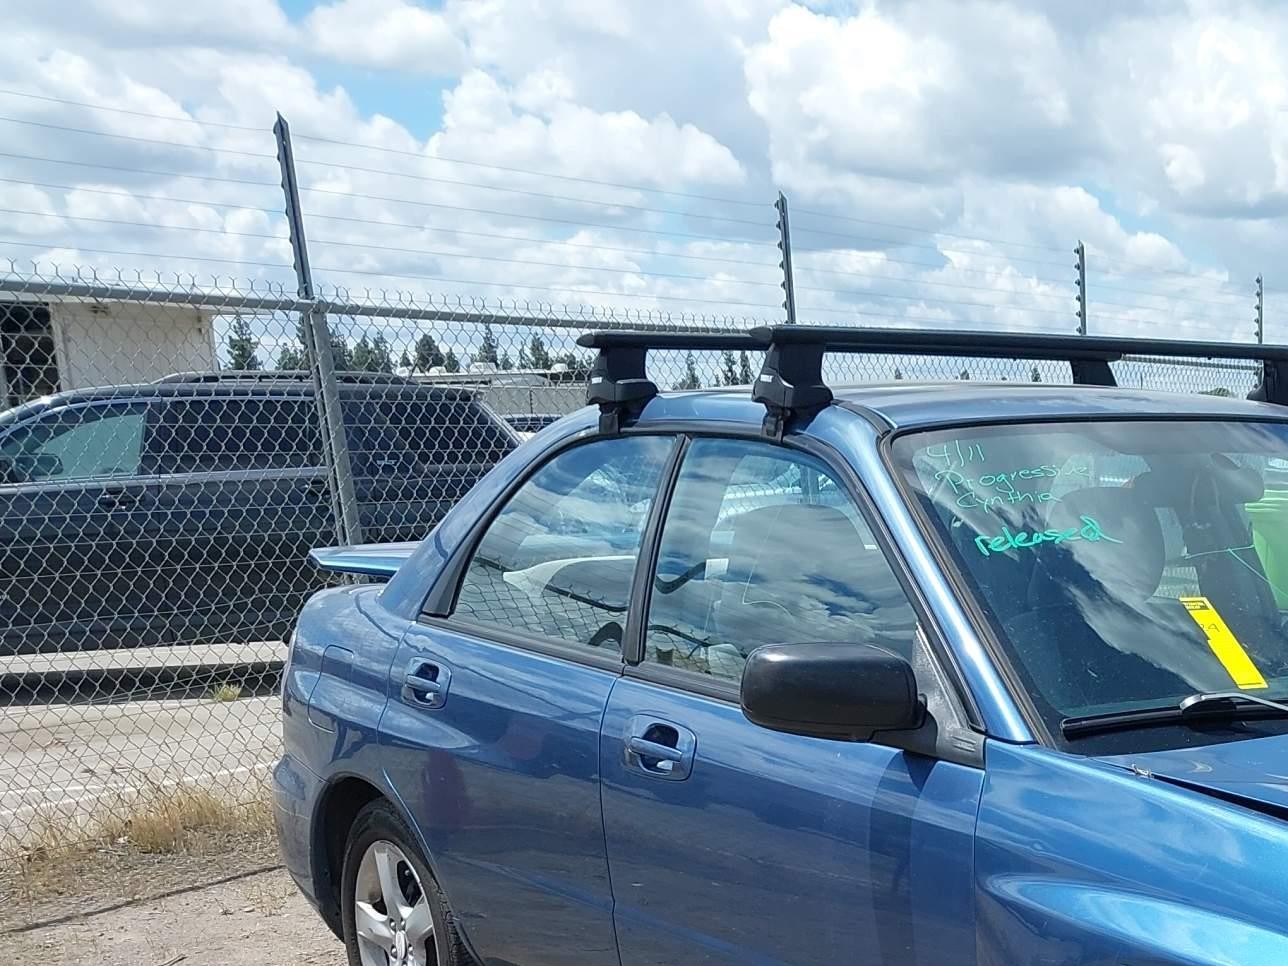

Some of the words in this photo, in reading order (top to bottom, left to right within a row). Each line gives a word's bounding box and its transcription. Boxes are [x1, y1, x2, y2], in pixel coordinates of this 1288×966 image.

[926, 439, 985, 468] 4/11
[934, 464, 1090, 495] Progressive
[956, 490, 1064, 514] Cynthia
[974, 513, 1124, 557] released
